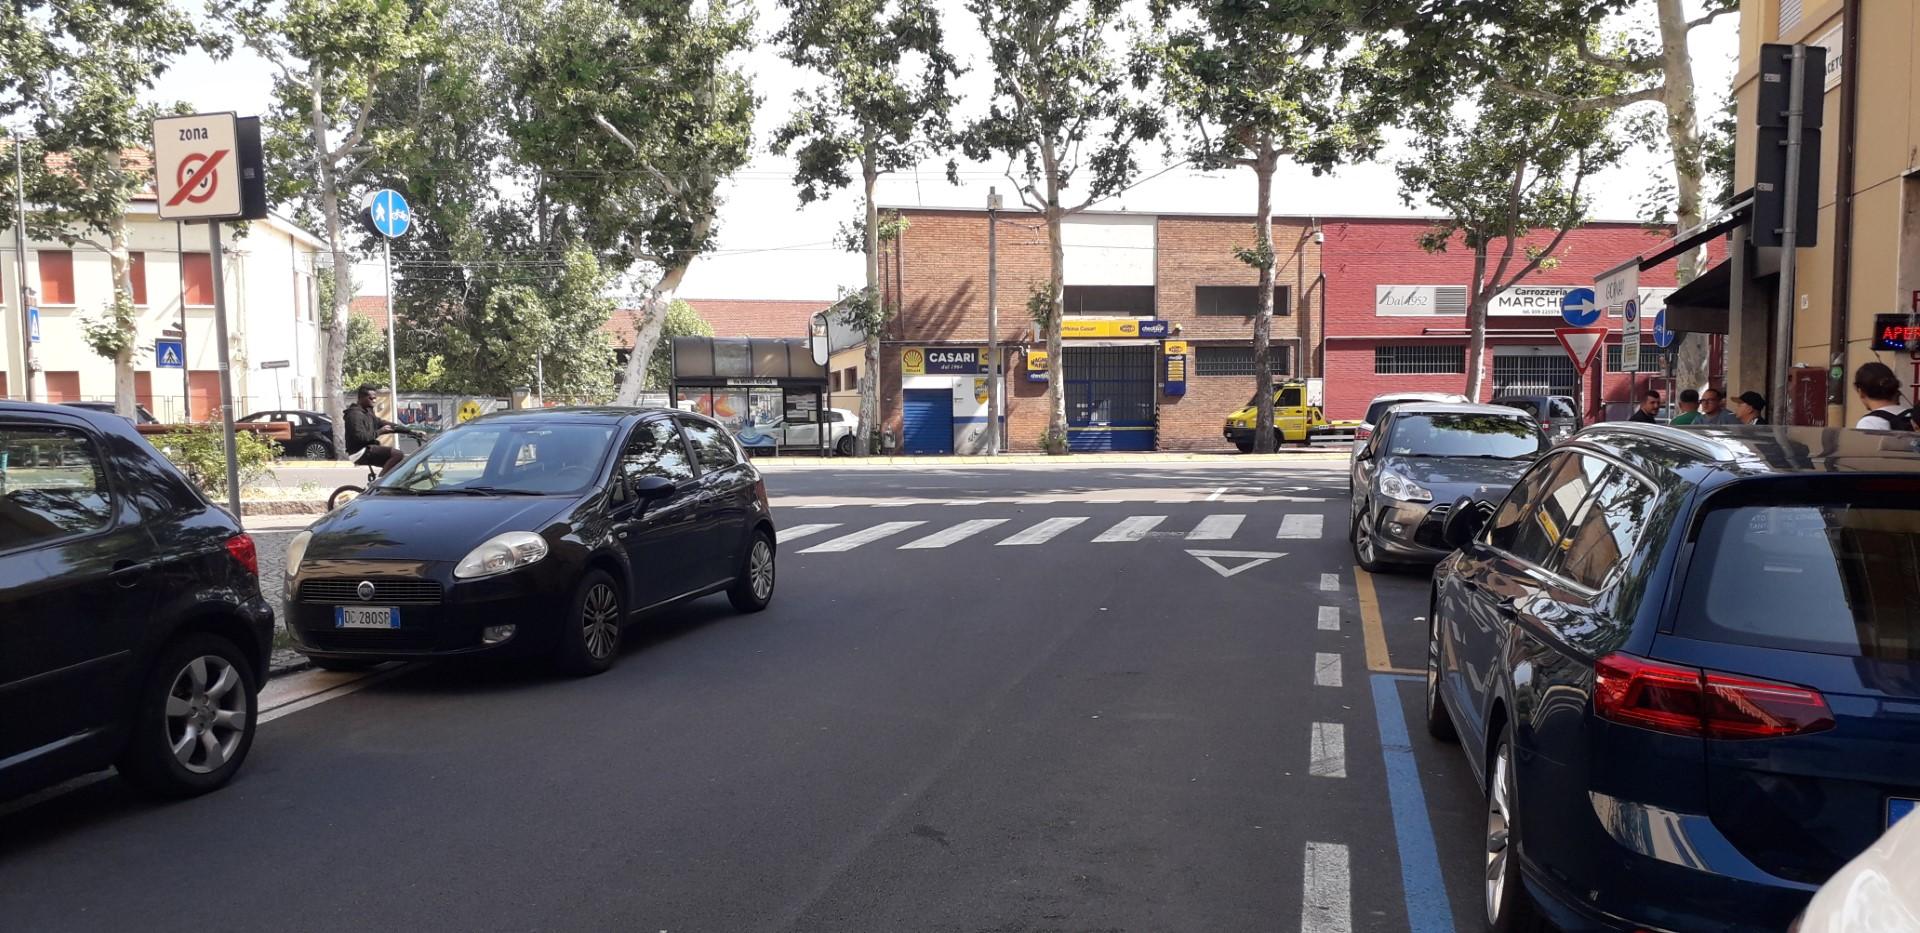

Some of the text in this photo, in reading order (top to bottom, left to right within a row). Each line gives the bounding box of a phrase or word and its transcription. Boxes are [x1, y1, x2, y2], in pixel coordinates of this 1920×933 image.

[179, 127, 208, 141] zona
[1515, 288, 1568, 296] Carrozzeria
[1386, 295, 1428, 306] Dal 1952
[929, 352, 975, 363] CASARI
